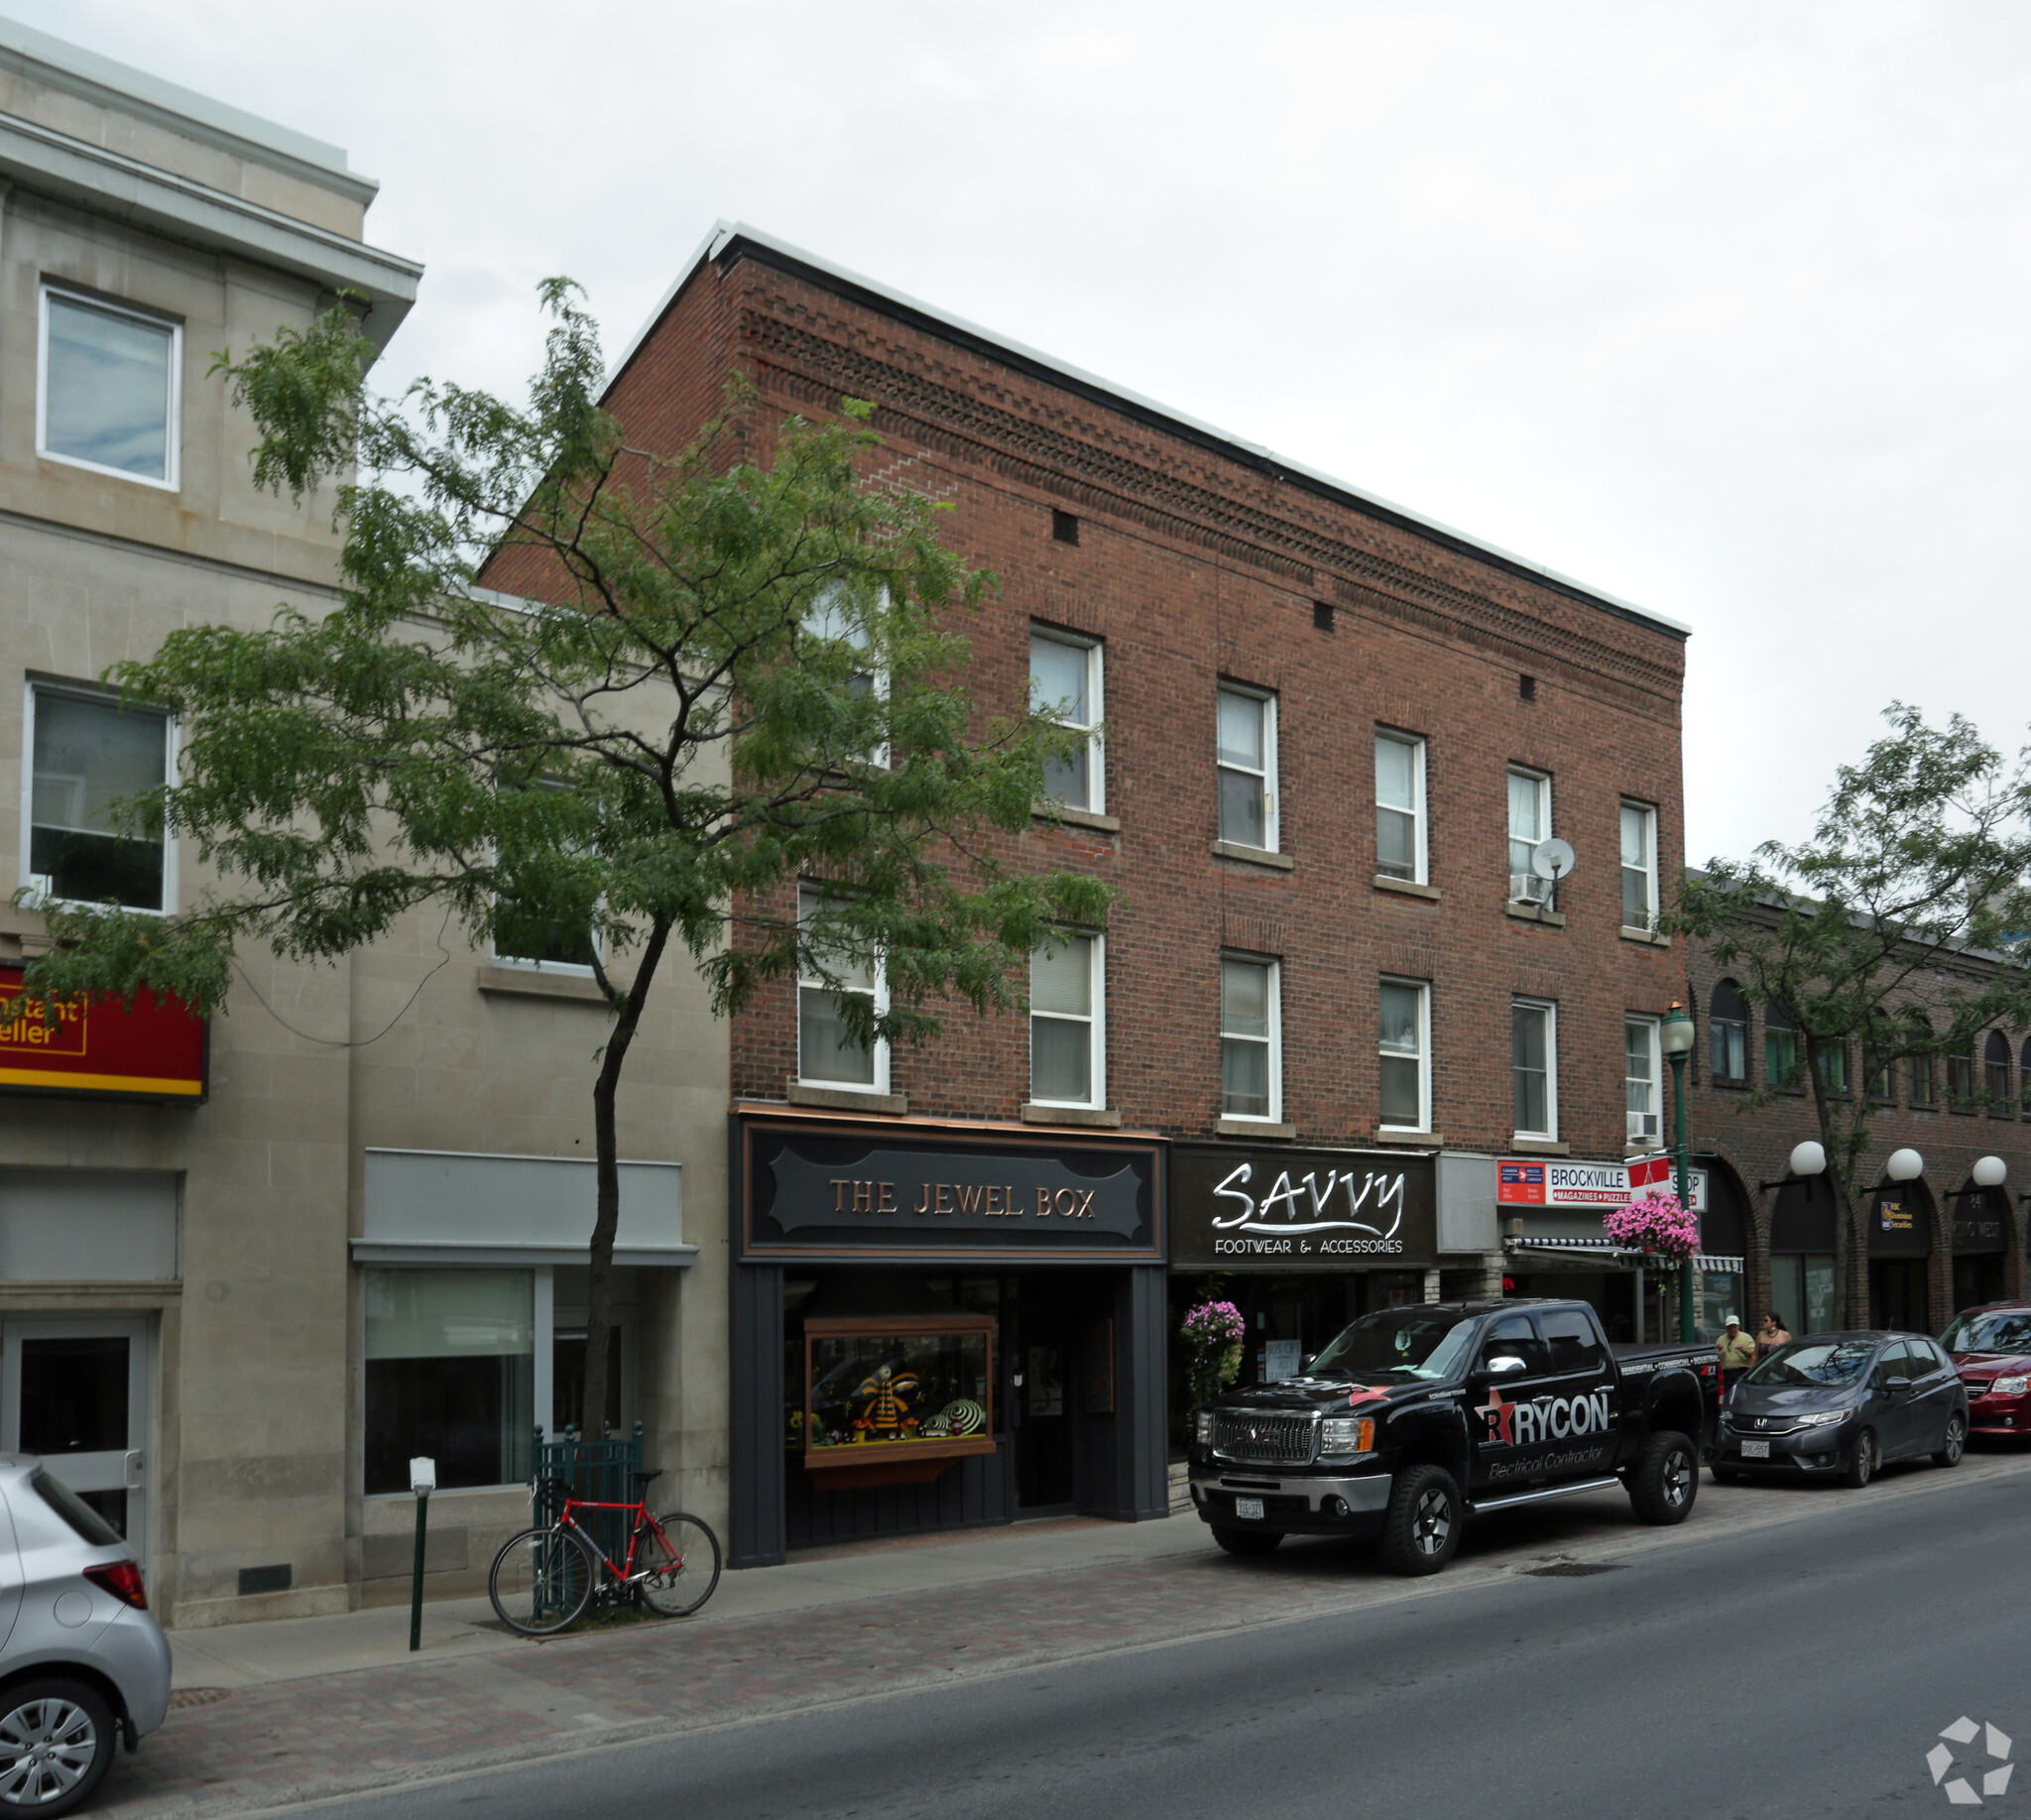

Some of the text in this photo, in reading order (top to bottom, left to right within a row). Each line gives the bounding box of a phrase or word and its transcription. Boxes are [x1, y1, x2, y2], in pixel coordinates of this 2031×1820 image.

[1551, 1168, 1700, 1191] BROCKVILLE SOP
[829, 1179, 1097, 1220] THE JEWEL BOX
[1211, 1162, 1405, 1240] SAVVY
[1557, 1191, 1633, 1202] MAGAZINES PUZZLES
[1215, 1240, 1403, 1255] FOOTWEAR & ACCESSORIES
[1620, 1354, 1721, 1377] RESIDENTIAL COMMERCIAL INDUSTRIAL
[1514, 1393, 1609, 1445] RYCON
[1489, 1447, 1604, 1479] Electrical Contractor
